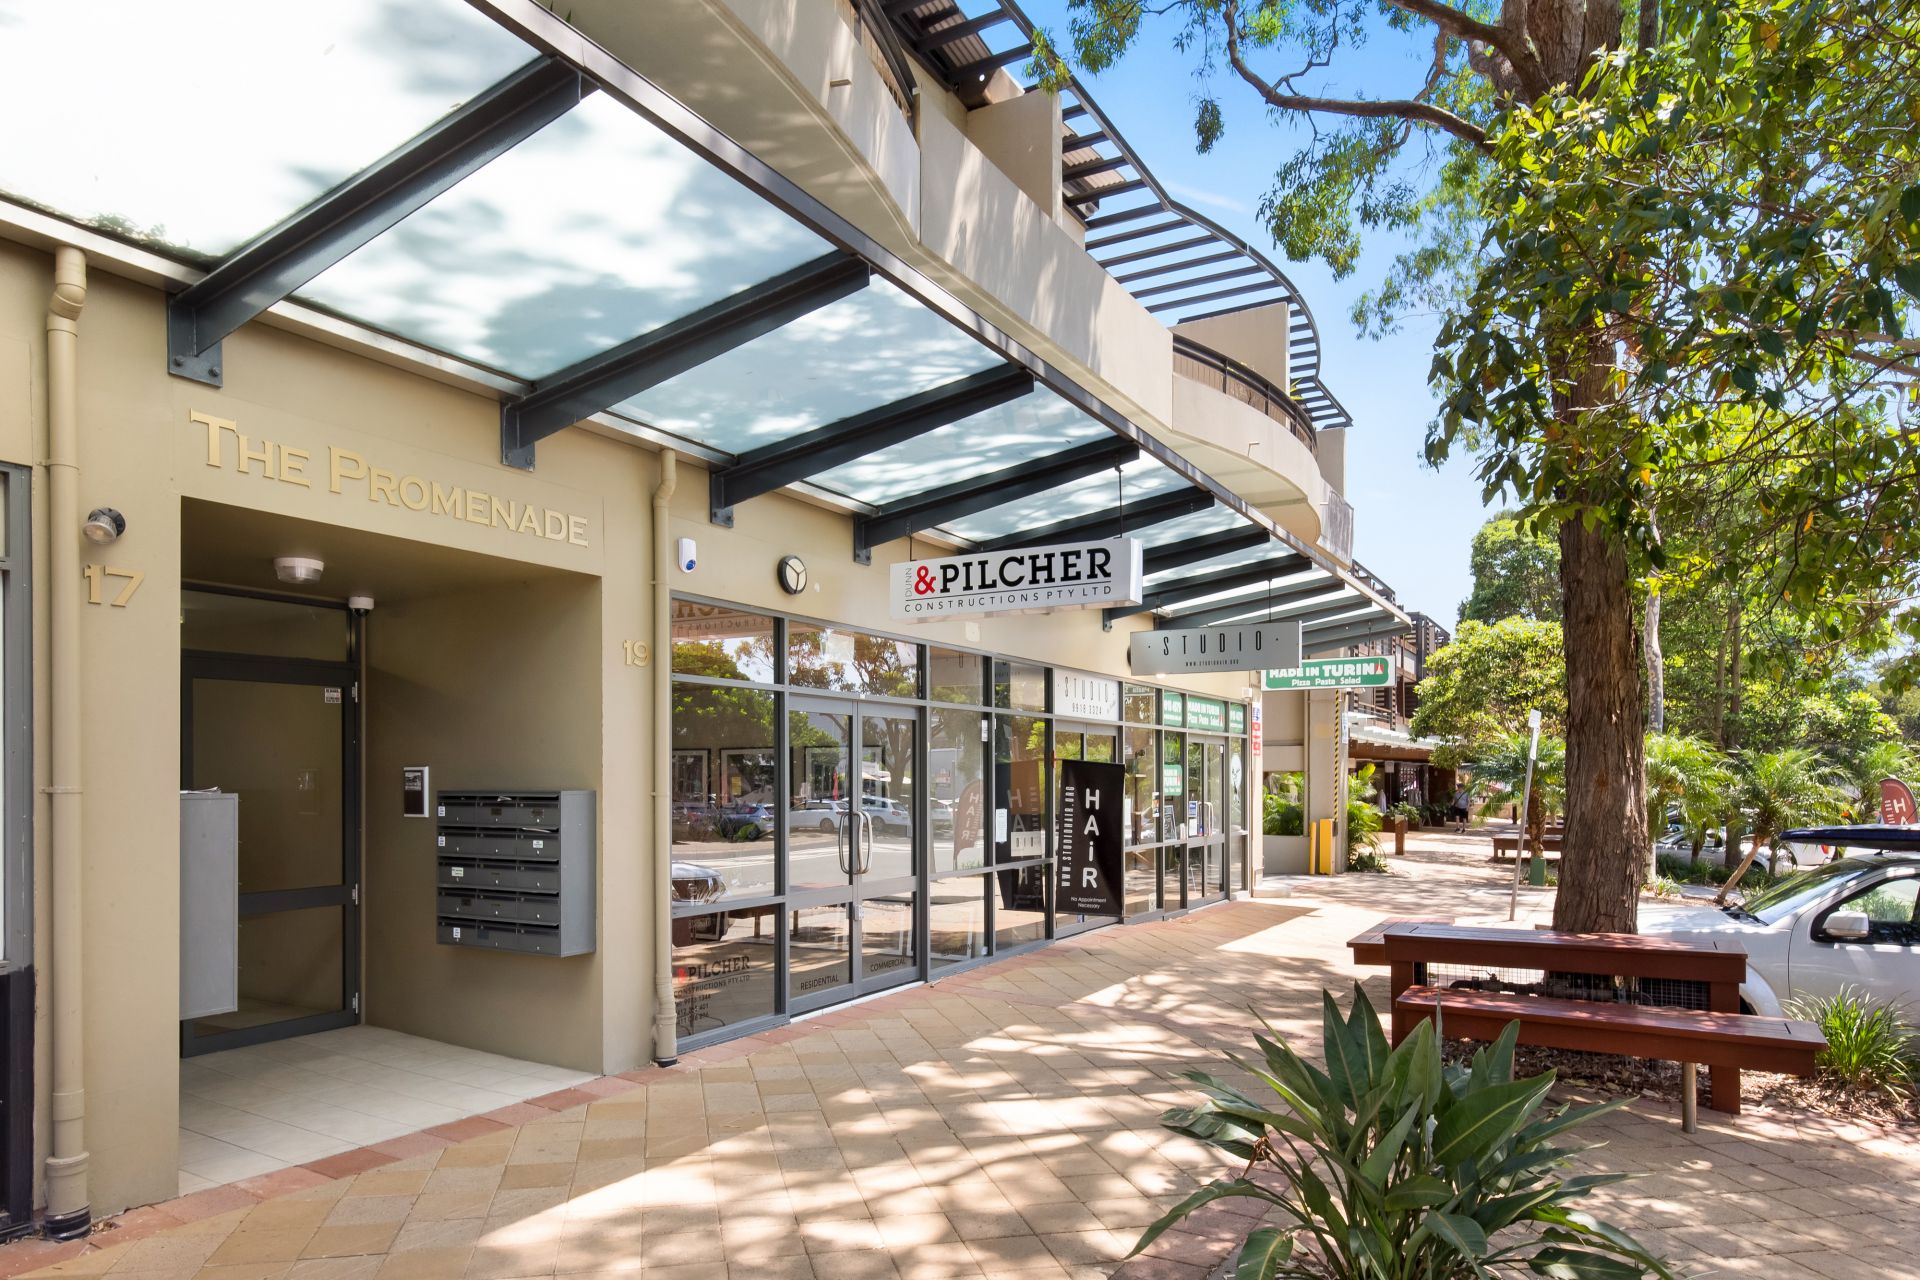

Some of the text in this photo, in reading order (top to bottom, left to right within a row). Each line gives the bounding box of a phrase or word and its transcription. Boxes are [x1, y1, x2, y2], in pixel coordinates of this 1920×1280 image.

[191, 408, 589, 549] THE PROMENADE
[82, 564, 145, 608] 17
[904, 567, 912, 598] DUNN
[904, 585, 1112, 613] CONSTRUCTIONS PTY LTD
[623, 639, 648, 667] 19
[1163, 630, 1262, 656] STUDIO
[1269, 663, 1375, 679] MADE IN TURIN
[1291, 677, 1361, 687] Pizza Pasta Salad
[1064, 676, 1108, 703] STUDIO
[870, 959, 906, 972] COMMERCIAL
[674, 980, 727, 998] CONSTRUCTIONS
[800, 974, 839, 991] RESIDENTIAL
